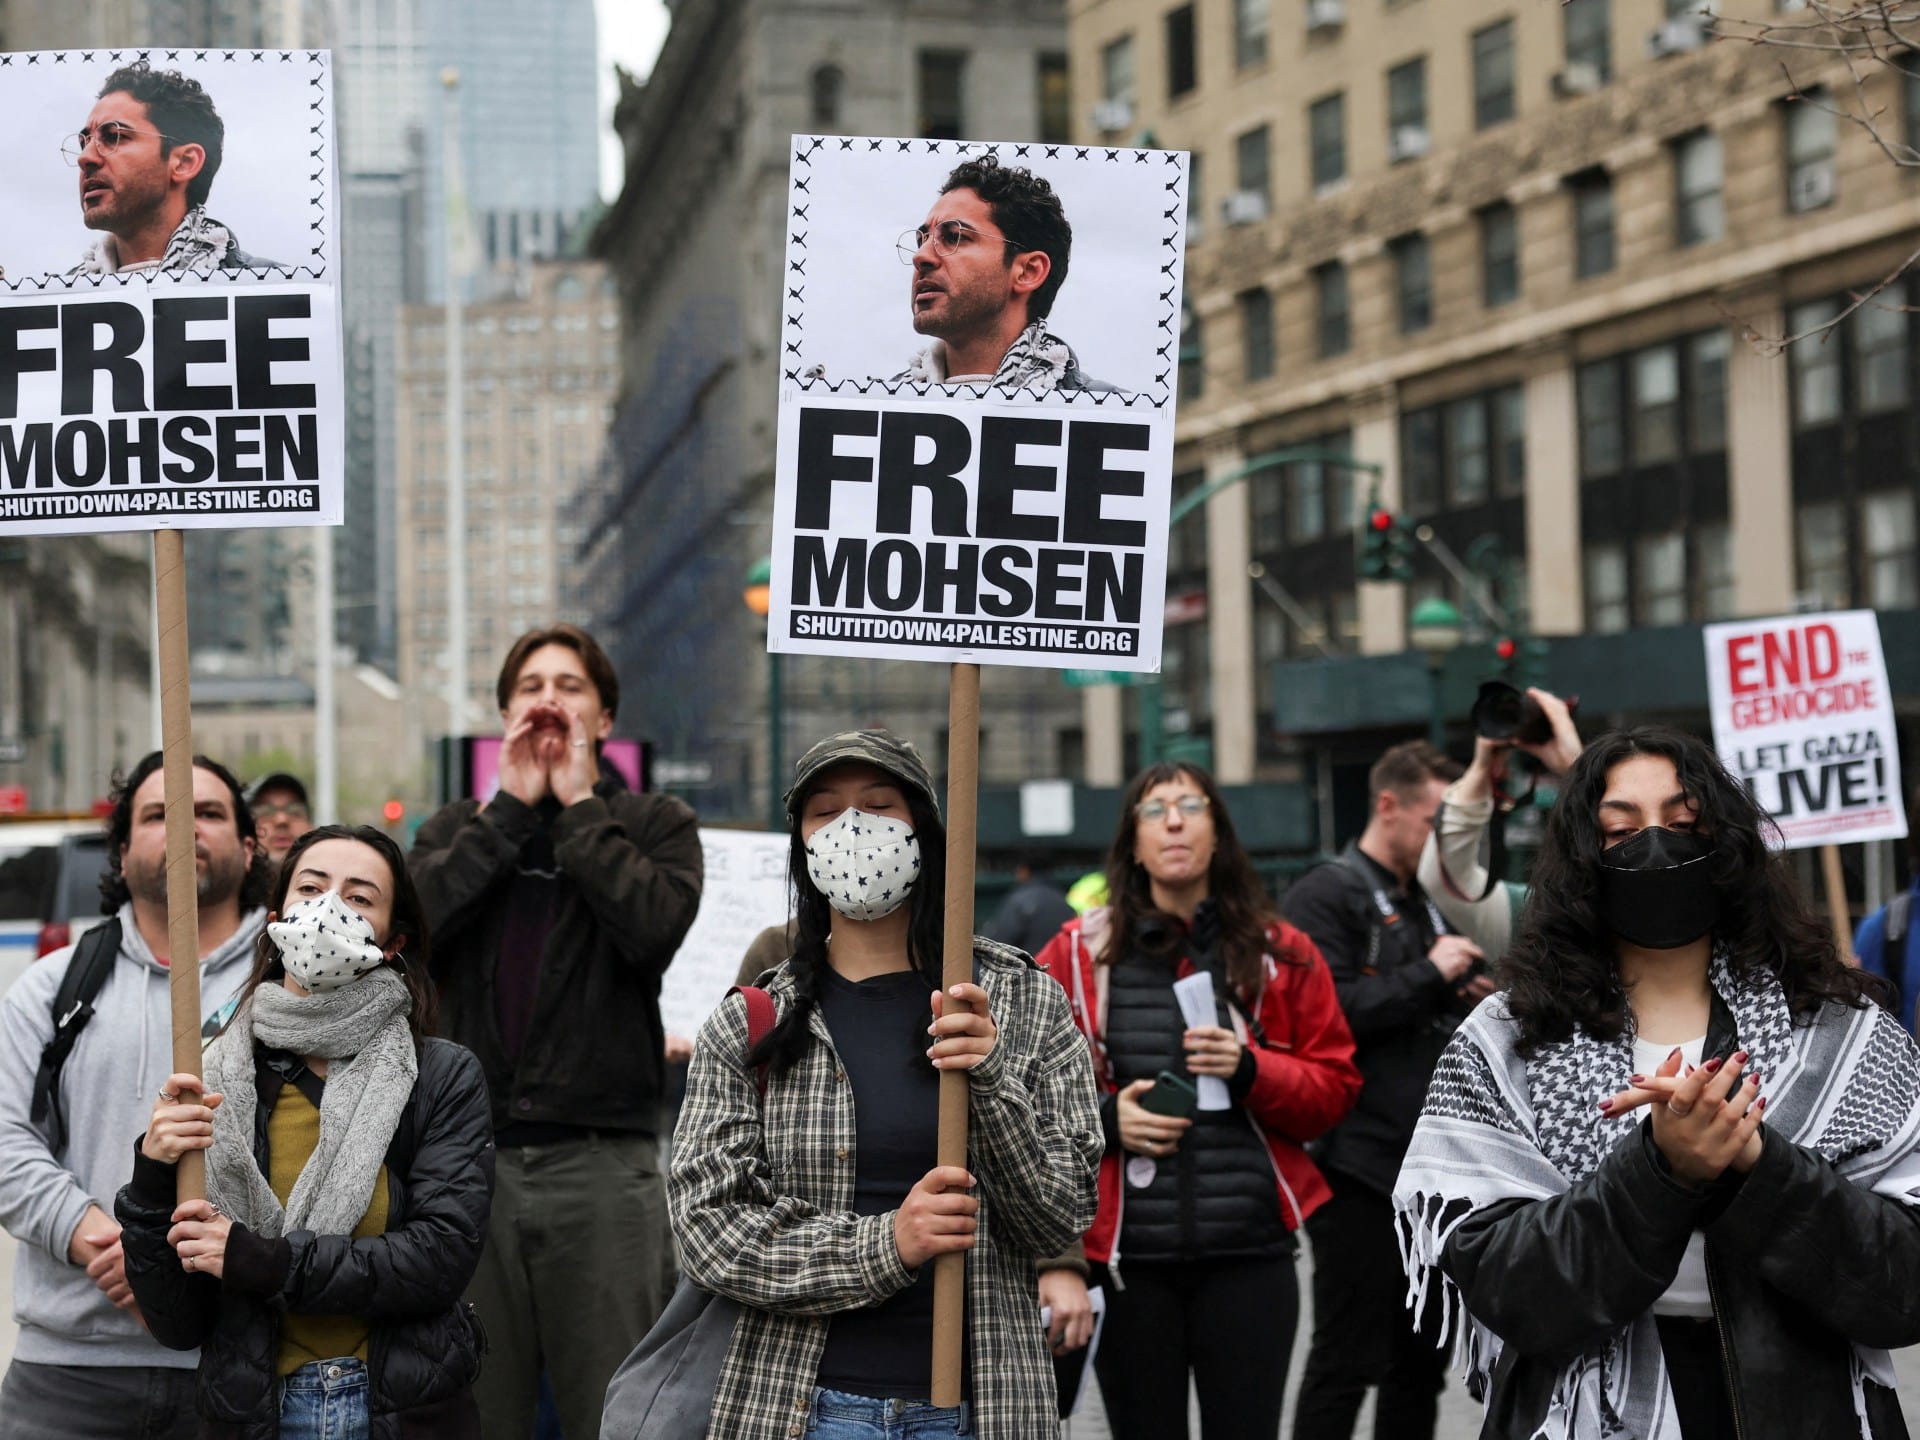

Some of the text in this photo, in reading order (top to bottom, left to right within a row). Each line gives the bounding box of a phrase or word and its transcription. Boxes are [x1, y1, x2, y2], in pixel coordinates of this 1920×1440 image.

[0, 294, 317, 418] FREE
[0, 414, 319, 489] MOHSEN
[795, 407, 1151, 548] FREE
[791, 535, 1145, 624] MOHSEN
[796, 614, 1132, 652] SHUTITDOWN4PALESTINE.ORG
[1727, 624, 1842, 694] END
[1731, 680, 1877, 730] GENOCIDE
[1738, 730, 1881, 771] LET GAZA
